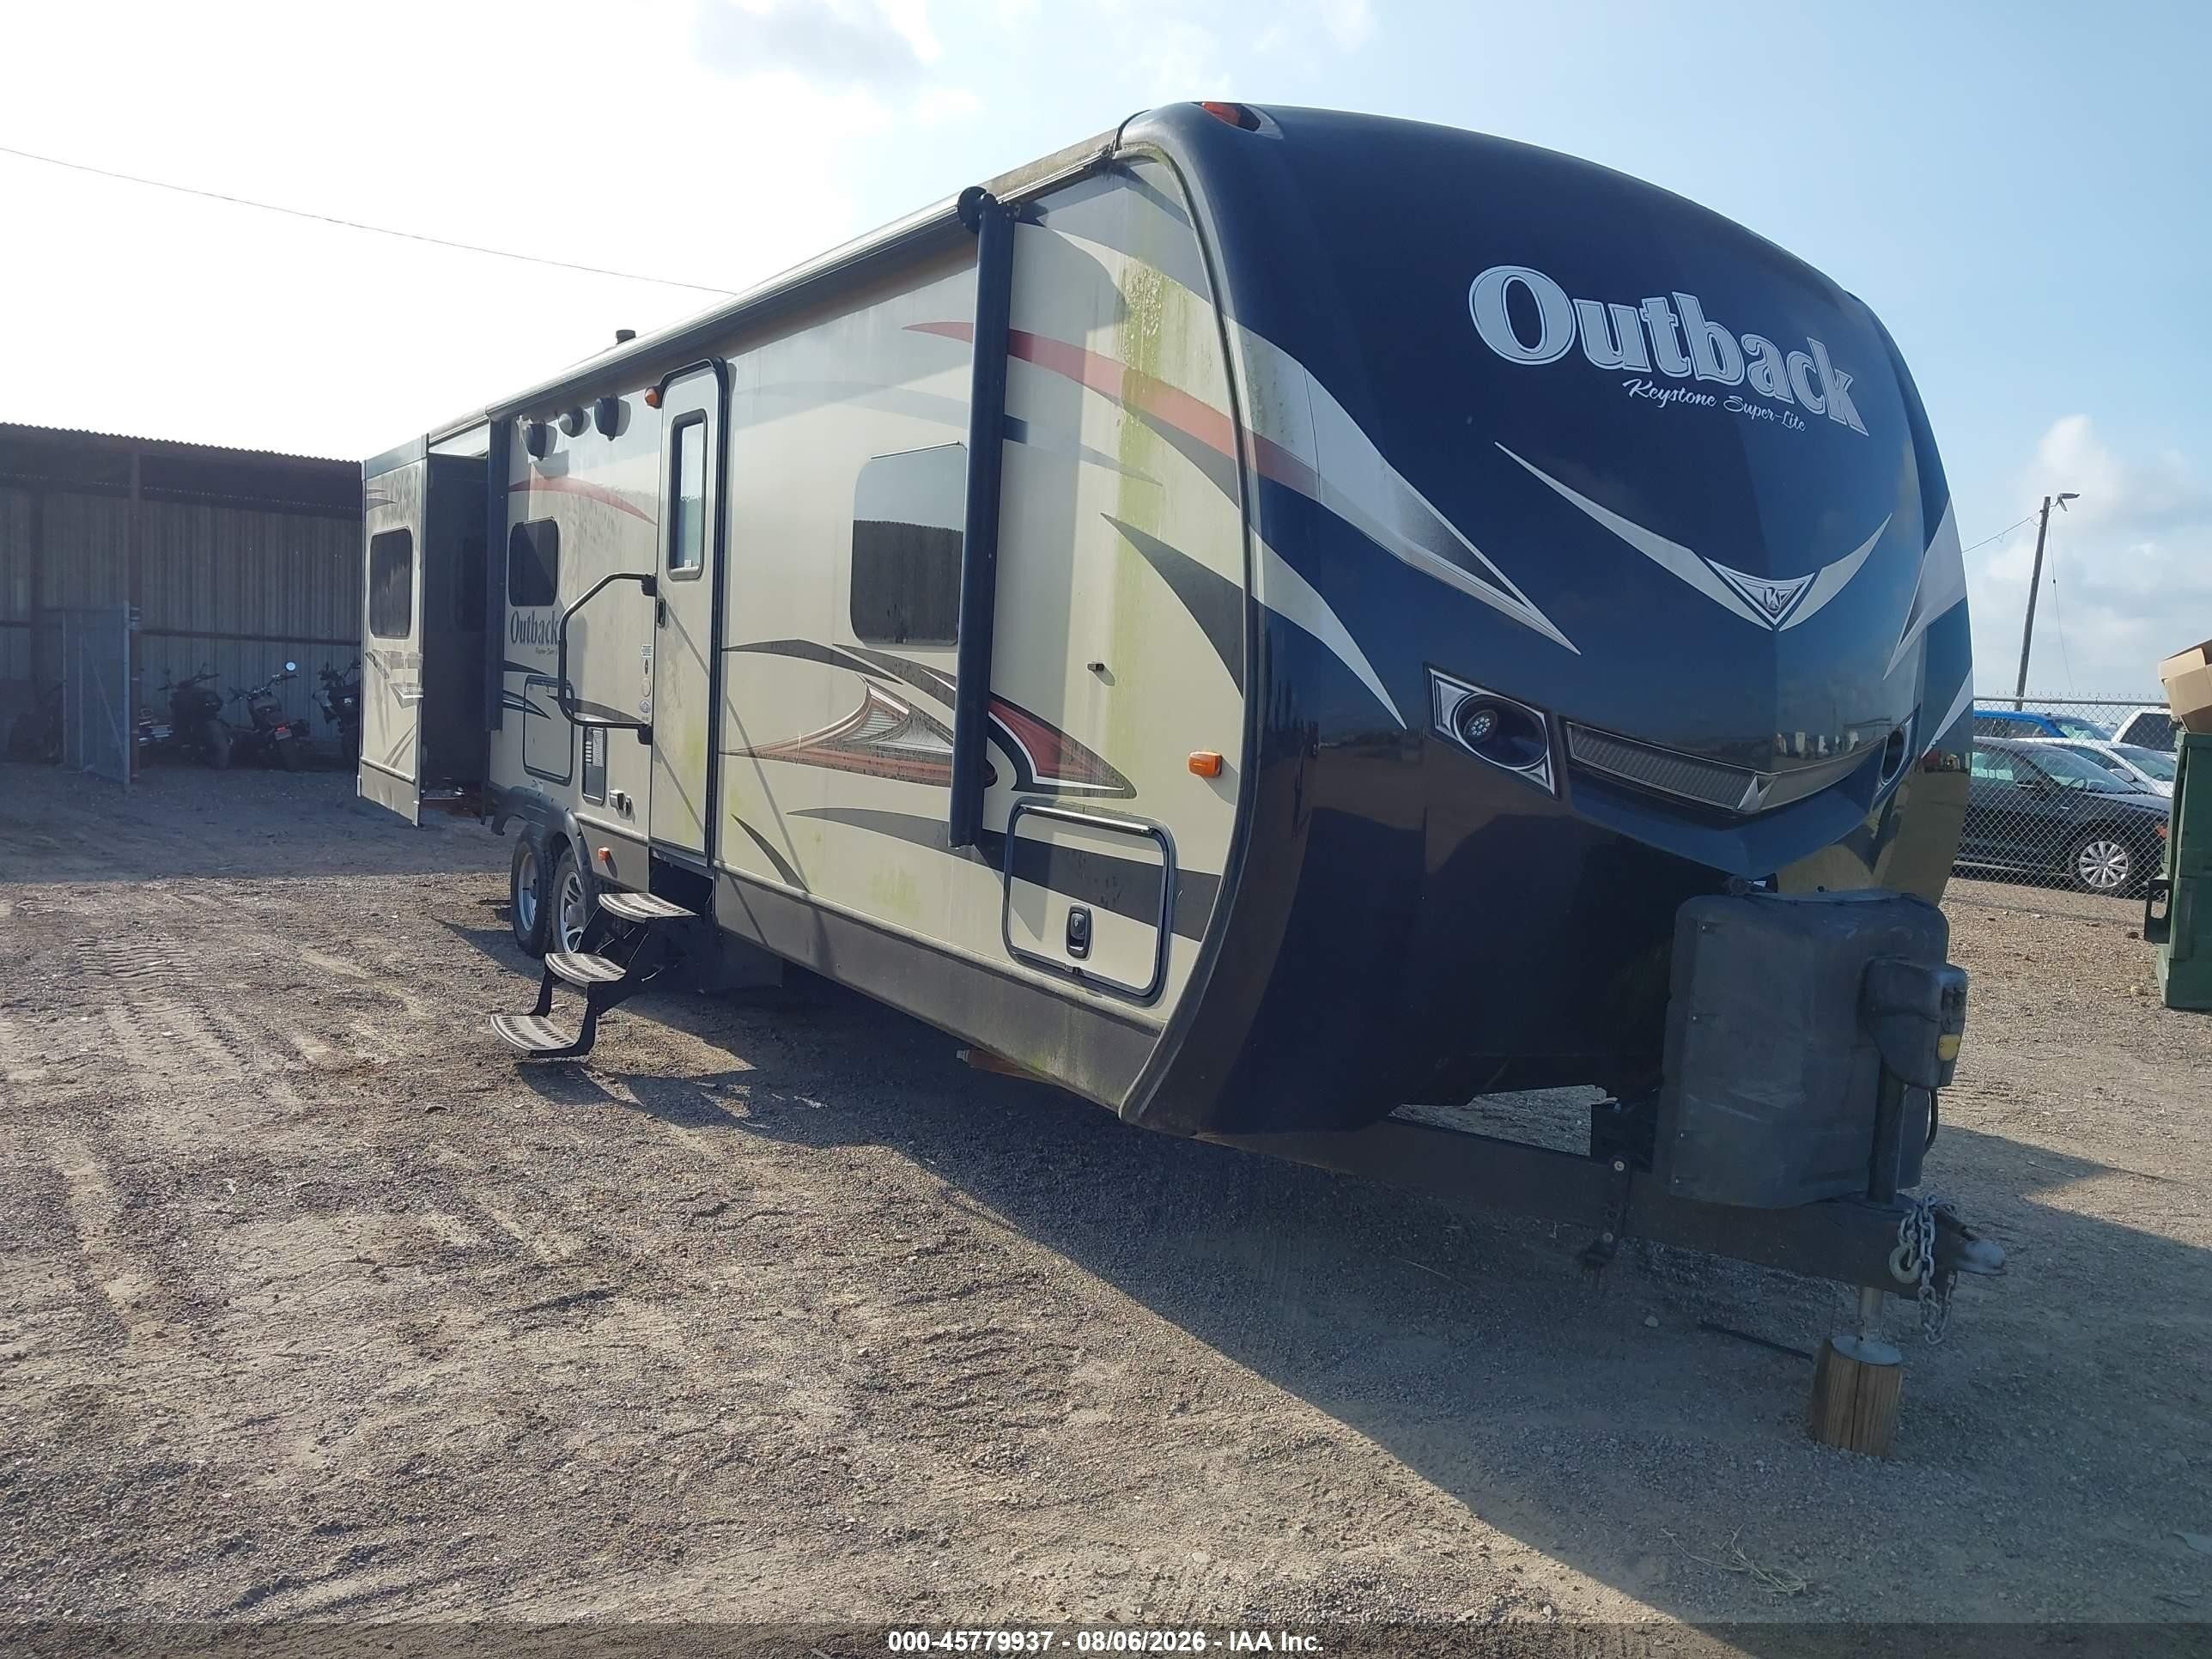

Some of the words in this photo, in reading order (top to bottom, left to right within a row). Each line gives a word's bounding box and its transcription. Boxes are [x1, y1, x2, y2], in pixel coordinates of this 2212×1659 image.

[1468, 265, 1869, 436] Outback
[1622, 378, 1717, 409] Keystone
[1723, 395, 1806, 432] Super-Lite
[510, 611, 559, 645] Outback
